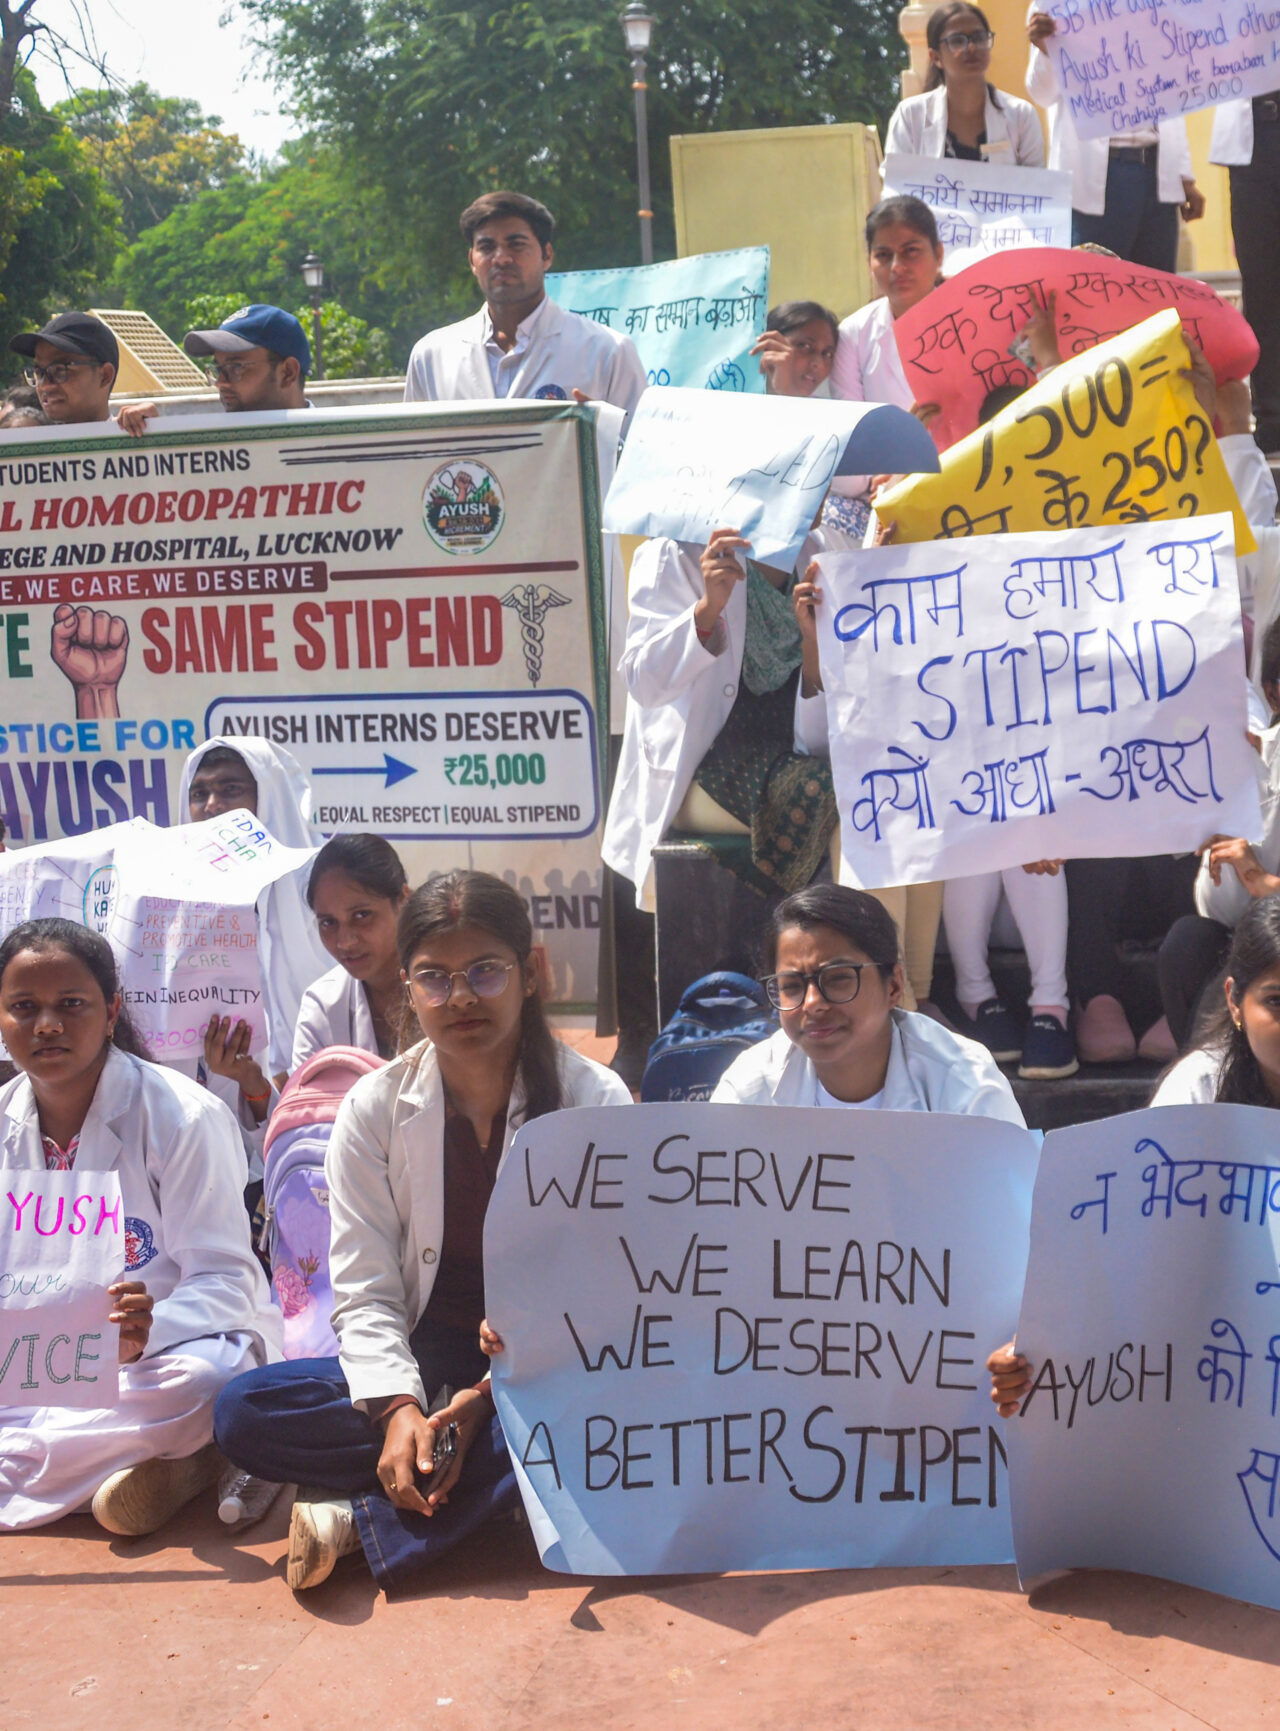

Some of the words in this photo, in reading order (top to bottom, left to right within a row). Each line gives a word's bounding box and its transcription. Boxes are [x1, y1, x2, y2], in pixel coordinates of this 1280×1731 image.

[1059, 36, 1121, 89] Ayush
[1161, 13, 1229, 60] Stipend
[1069, 82, 1128, 118] Medical
[970, 189, 1053, 215] समानता
[625, 305, 655, 335] का
[655, 296, 705, 333] सम्मान
[102, 455, 150, 480] AND
[154, 448, 251, 476] INTERNS
[1102, 413, 1212, 516] 250?
[0, 500, 23, 532] L
[30, 479, 366, 530] HOMOEOPATHIC
[439, 502, 490, 518] AYUSH
[50, 543, 106, 567] AND
[110, 535, 250, 563] HOSPITAL,
[256, 526, 404, 557] LUCKNOW
[196, 566, 315, 591] DESERVE
[833, 562, 968, 653] काम
[1002, 538, 1126, 621] हमारा
[1146, 530, 1225, 596] पूरा
[0, 612, 34, 678] E
[140, 602, 279, 676] SAME
[293, 594, 504, 673] STIPEND
[911, 619, 1197, 741] STIPEND
[115, 719, 196, 752] FOR
[220, 714, 309, 744] AYUSH
[315, 712, 437, 743] INTERNS
[445, 709, 583, 742] DESERVE
[444, 752, 547, 790] ₹25,000
[319, 806, 370, 823] EQUAL
[373, 806, 442, 823] RESPECT
[451, 805, 503, 823] EQUAL
[506, 804, 581, 823] STIPEND
[851, 745, 932, 843] क्यों
[145, 914, 225, 930] PREVENTIVE
[230, 914, 241, 931] &
[213, 932, 258, 948] HEALTH
[187, 953, 232, 968] CARE
[160, 985, 261, 1005] INEQUALITY
[525, 1141, 628, 1208] WE
[647, 1134, 855, 1213] SERVE
[6, 1190, 122, 1237] YUSH
[1070, 1173, 1118, 1234] न
[619, 1232, 728, 1296] WE
[772, 1239, 952, 1307] LEARN
[564, 1303, 675, 1372] WE
[714, 1306, 978, 1391] DESERVE
[1019, 1341, 1173, 1429] AYUSH
[1196, 1317, 1253, 1408] को
[522, 1421, 563, 1490] A
[584, 1407, 795, 1491] BETTER
